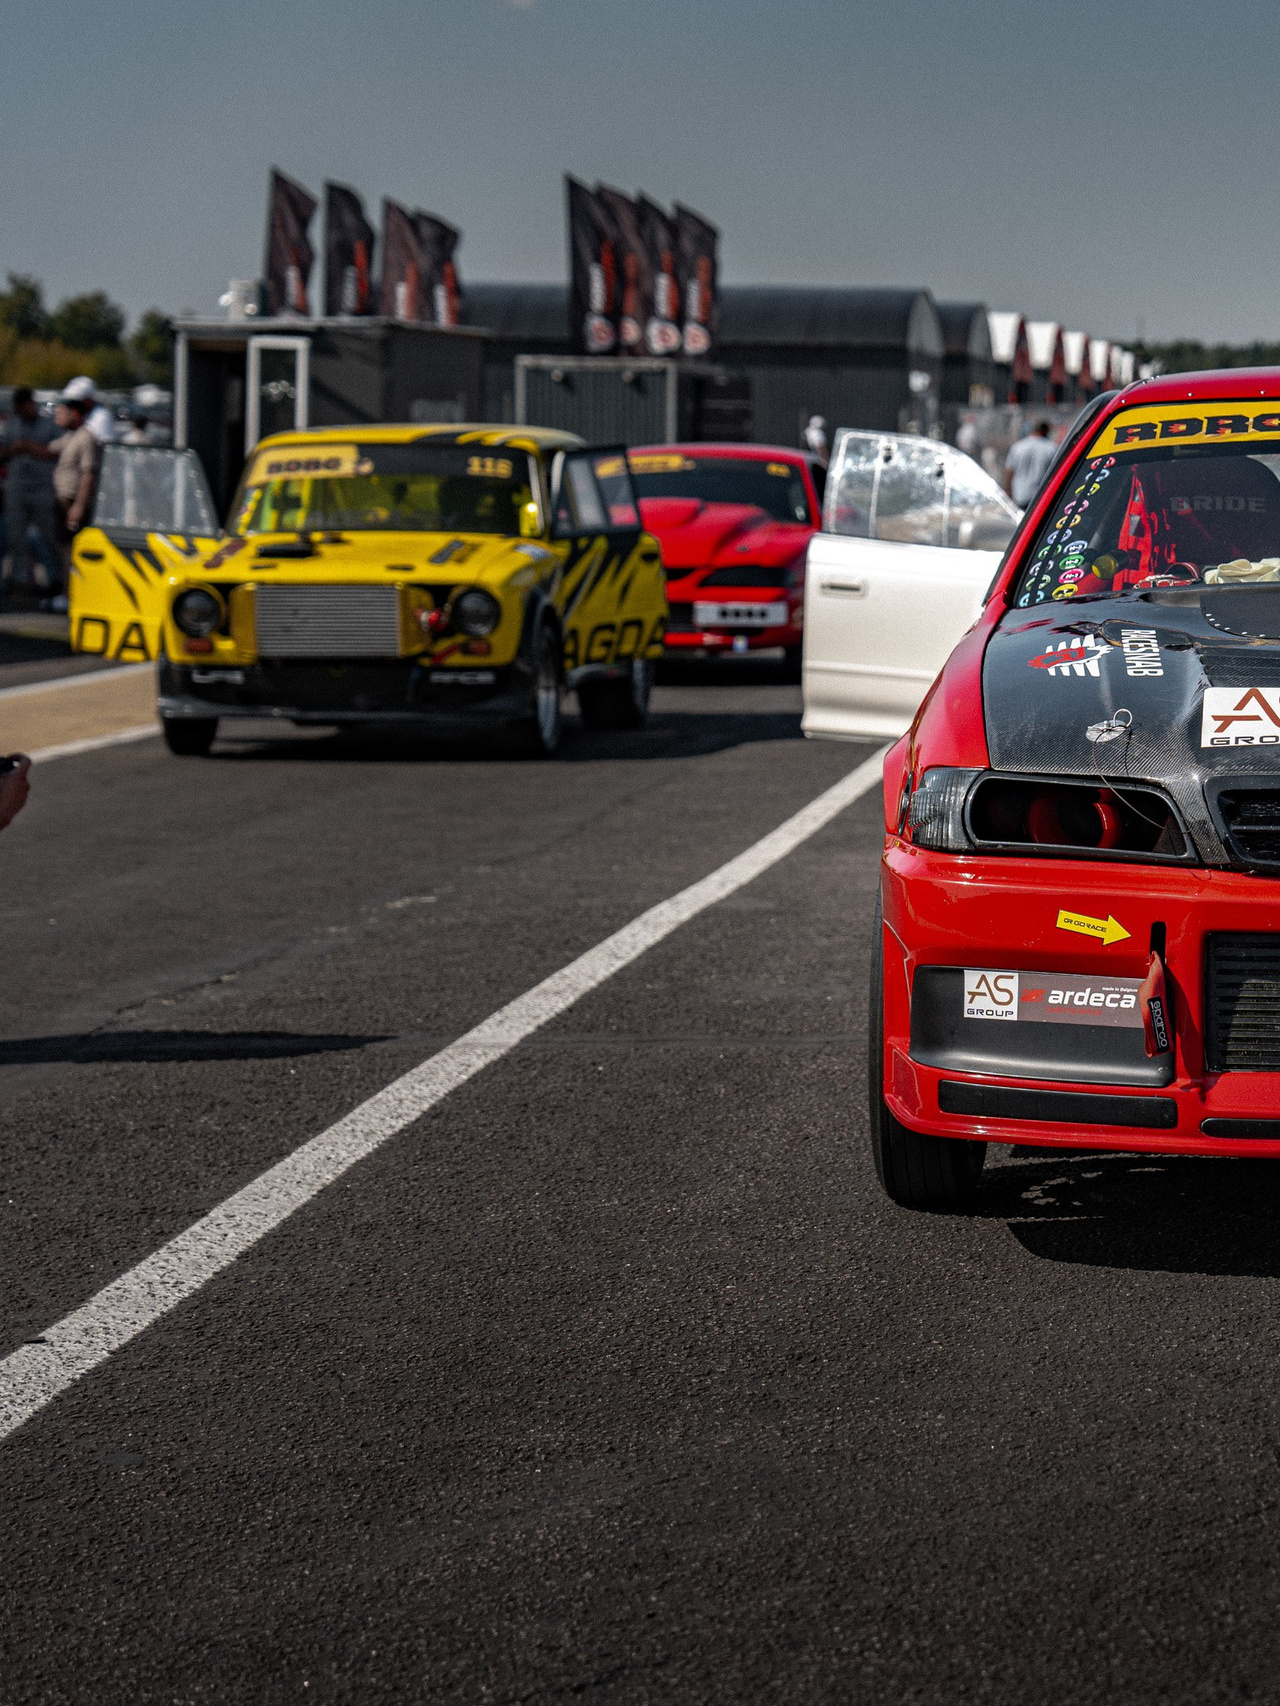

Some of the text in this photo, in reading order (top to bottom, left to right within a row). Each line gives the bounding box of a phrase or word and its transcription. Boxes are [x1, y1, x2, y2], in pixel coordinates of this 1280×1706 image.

[1168, 496, 1267, 513] BRIDE
[1120, 629, 1164, 677] RACESNAB
[967, 974, 1014, 1006] AS
[1048, 987, 1136, 1009] ardeca
[967, 1008, 1014, 1017] GROUP
